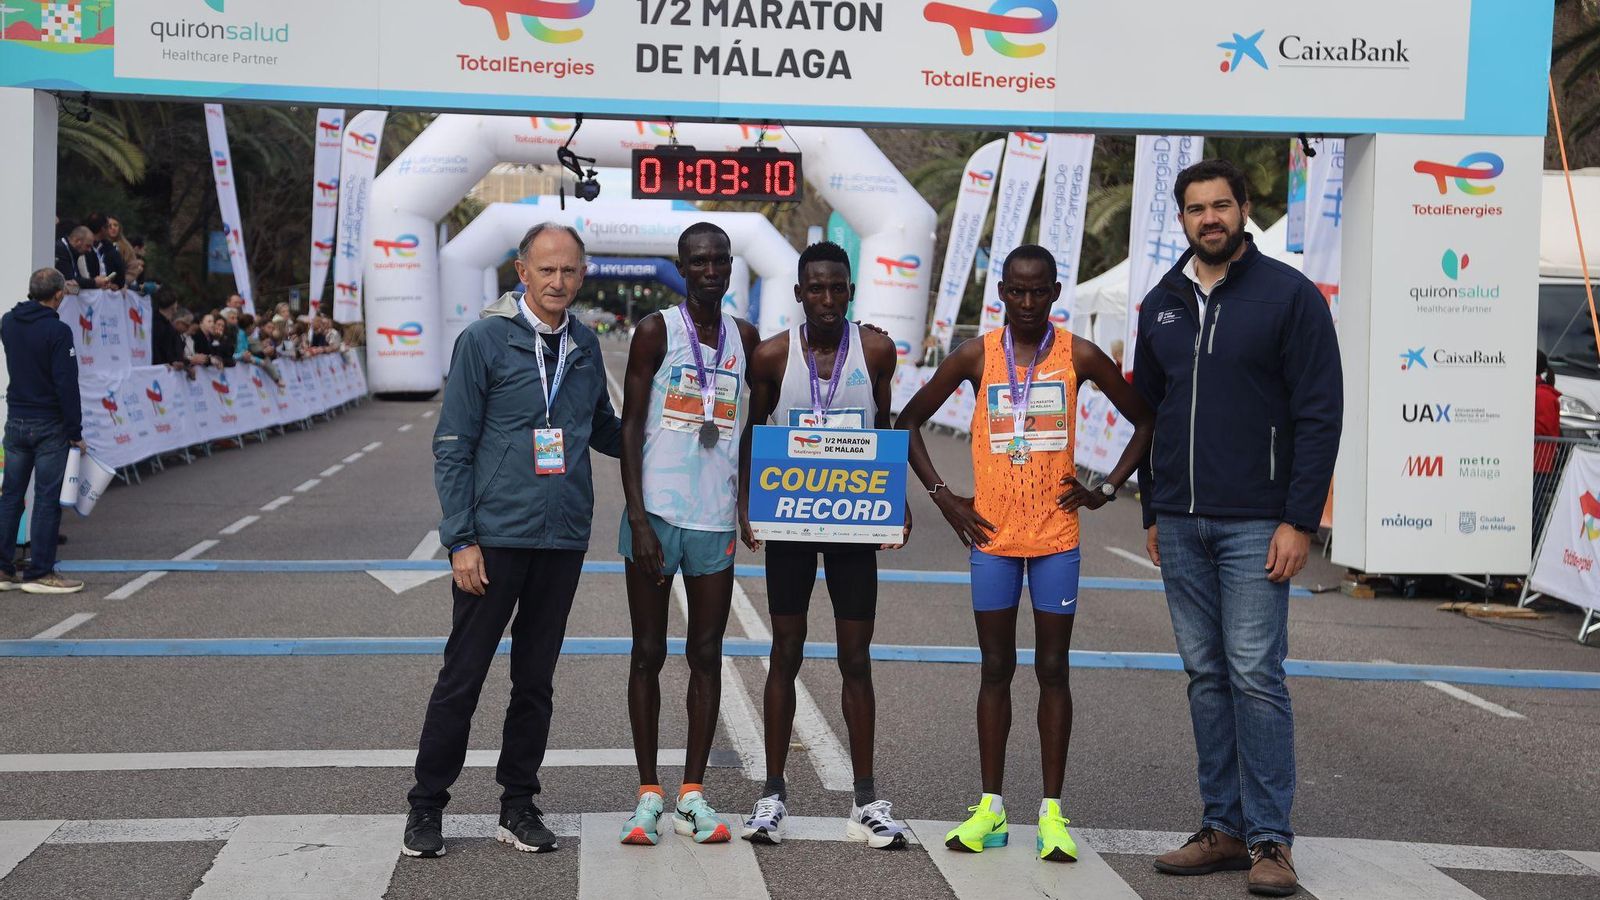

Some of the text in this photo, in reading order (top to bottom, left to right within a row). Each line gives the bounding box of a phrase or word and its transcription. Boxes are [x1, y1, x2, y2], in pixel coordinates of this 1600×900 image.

[636, 0, 691, 26] 1/2
[162, 49, 278, 66] Healthcare Partner
[1278, 35, 1410, 63] CaixaBank
[457, 54, 595, 76] TotalEnergies
[636, 39, 852, 79] DE MÁLAGA
[921, 70, 1056, 92] TotalEnergies
[1412, 203, 1503, 218] TotalEnergies
[1416, 304, 1492, 313] Healthcare Partner
[1433, 349, 1506, 364] CaixaBank
[1402, 403, 1451, 422] UAX
[1024, 415, 1036, 432] 2
[835, 445, 864, 454] MÁLAGA
[837, 437, 870, 446] MARATÓN
[1459, 456, 1500, 465] metro
[759, 466, 889, 494] COURSE
[1459, 466, 1500, 479] Málaga
[775, 497, 892, 521] RECORD
